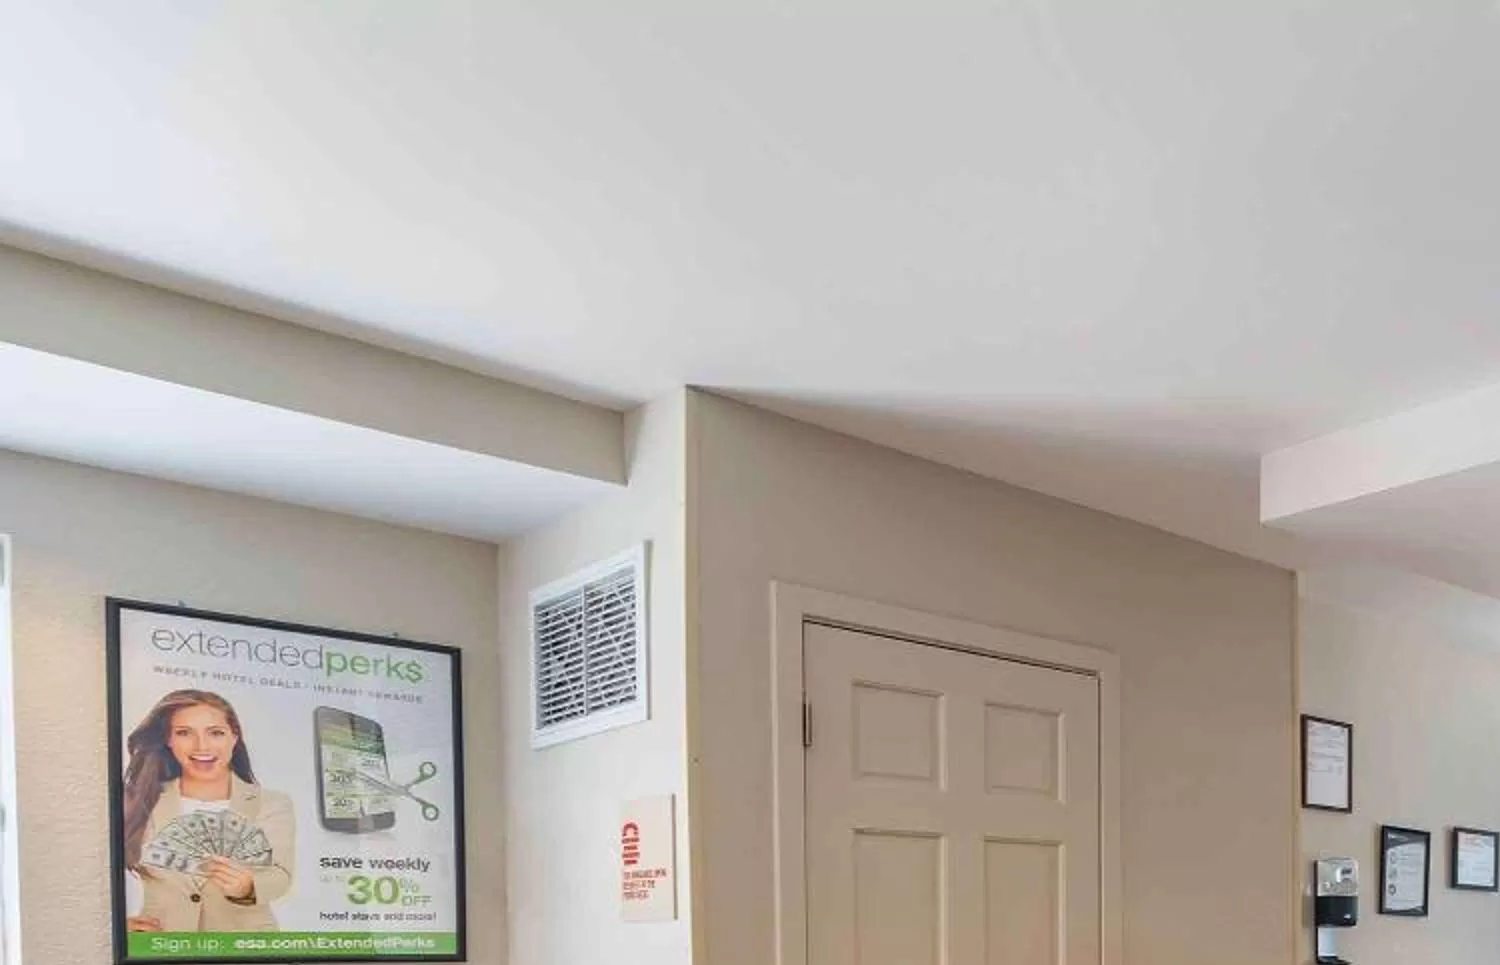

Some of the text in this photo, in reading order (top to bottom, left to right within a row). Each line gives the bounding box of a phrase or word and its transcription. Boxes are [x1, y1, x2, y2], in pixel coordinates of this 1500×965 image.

[151, 629, 424, 684] extendedperks
[319, 857, 431, 872] save weekly
[402, 895, 432, 907] OFF
[151, 937, 190, 950] Sign
[197, 938, 224, 951] up:
